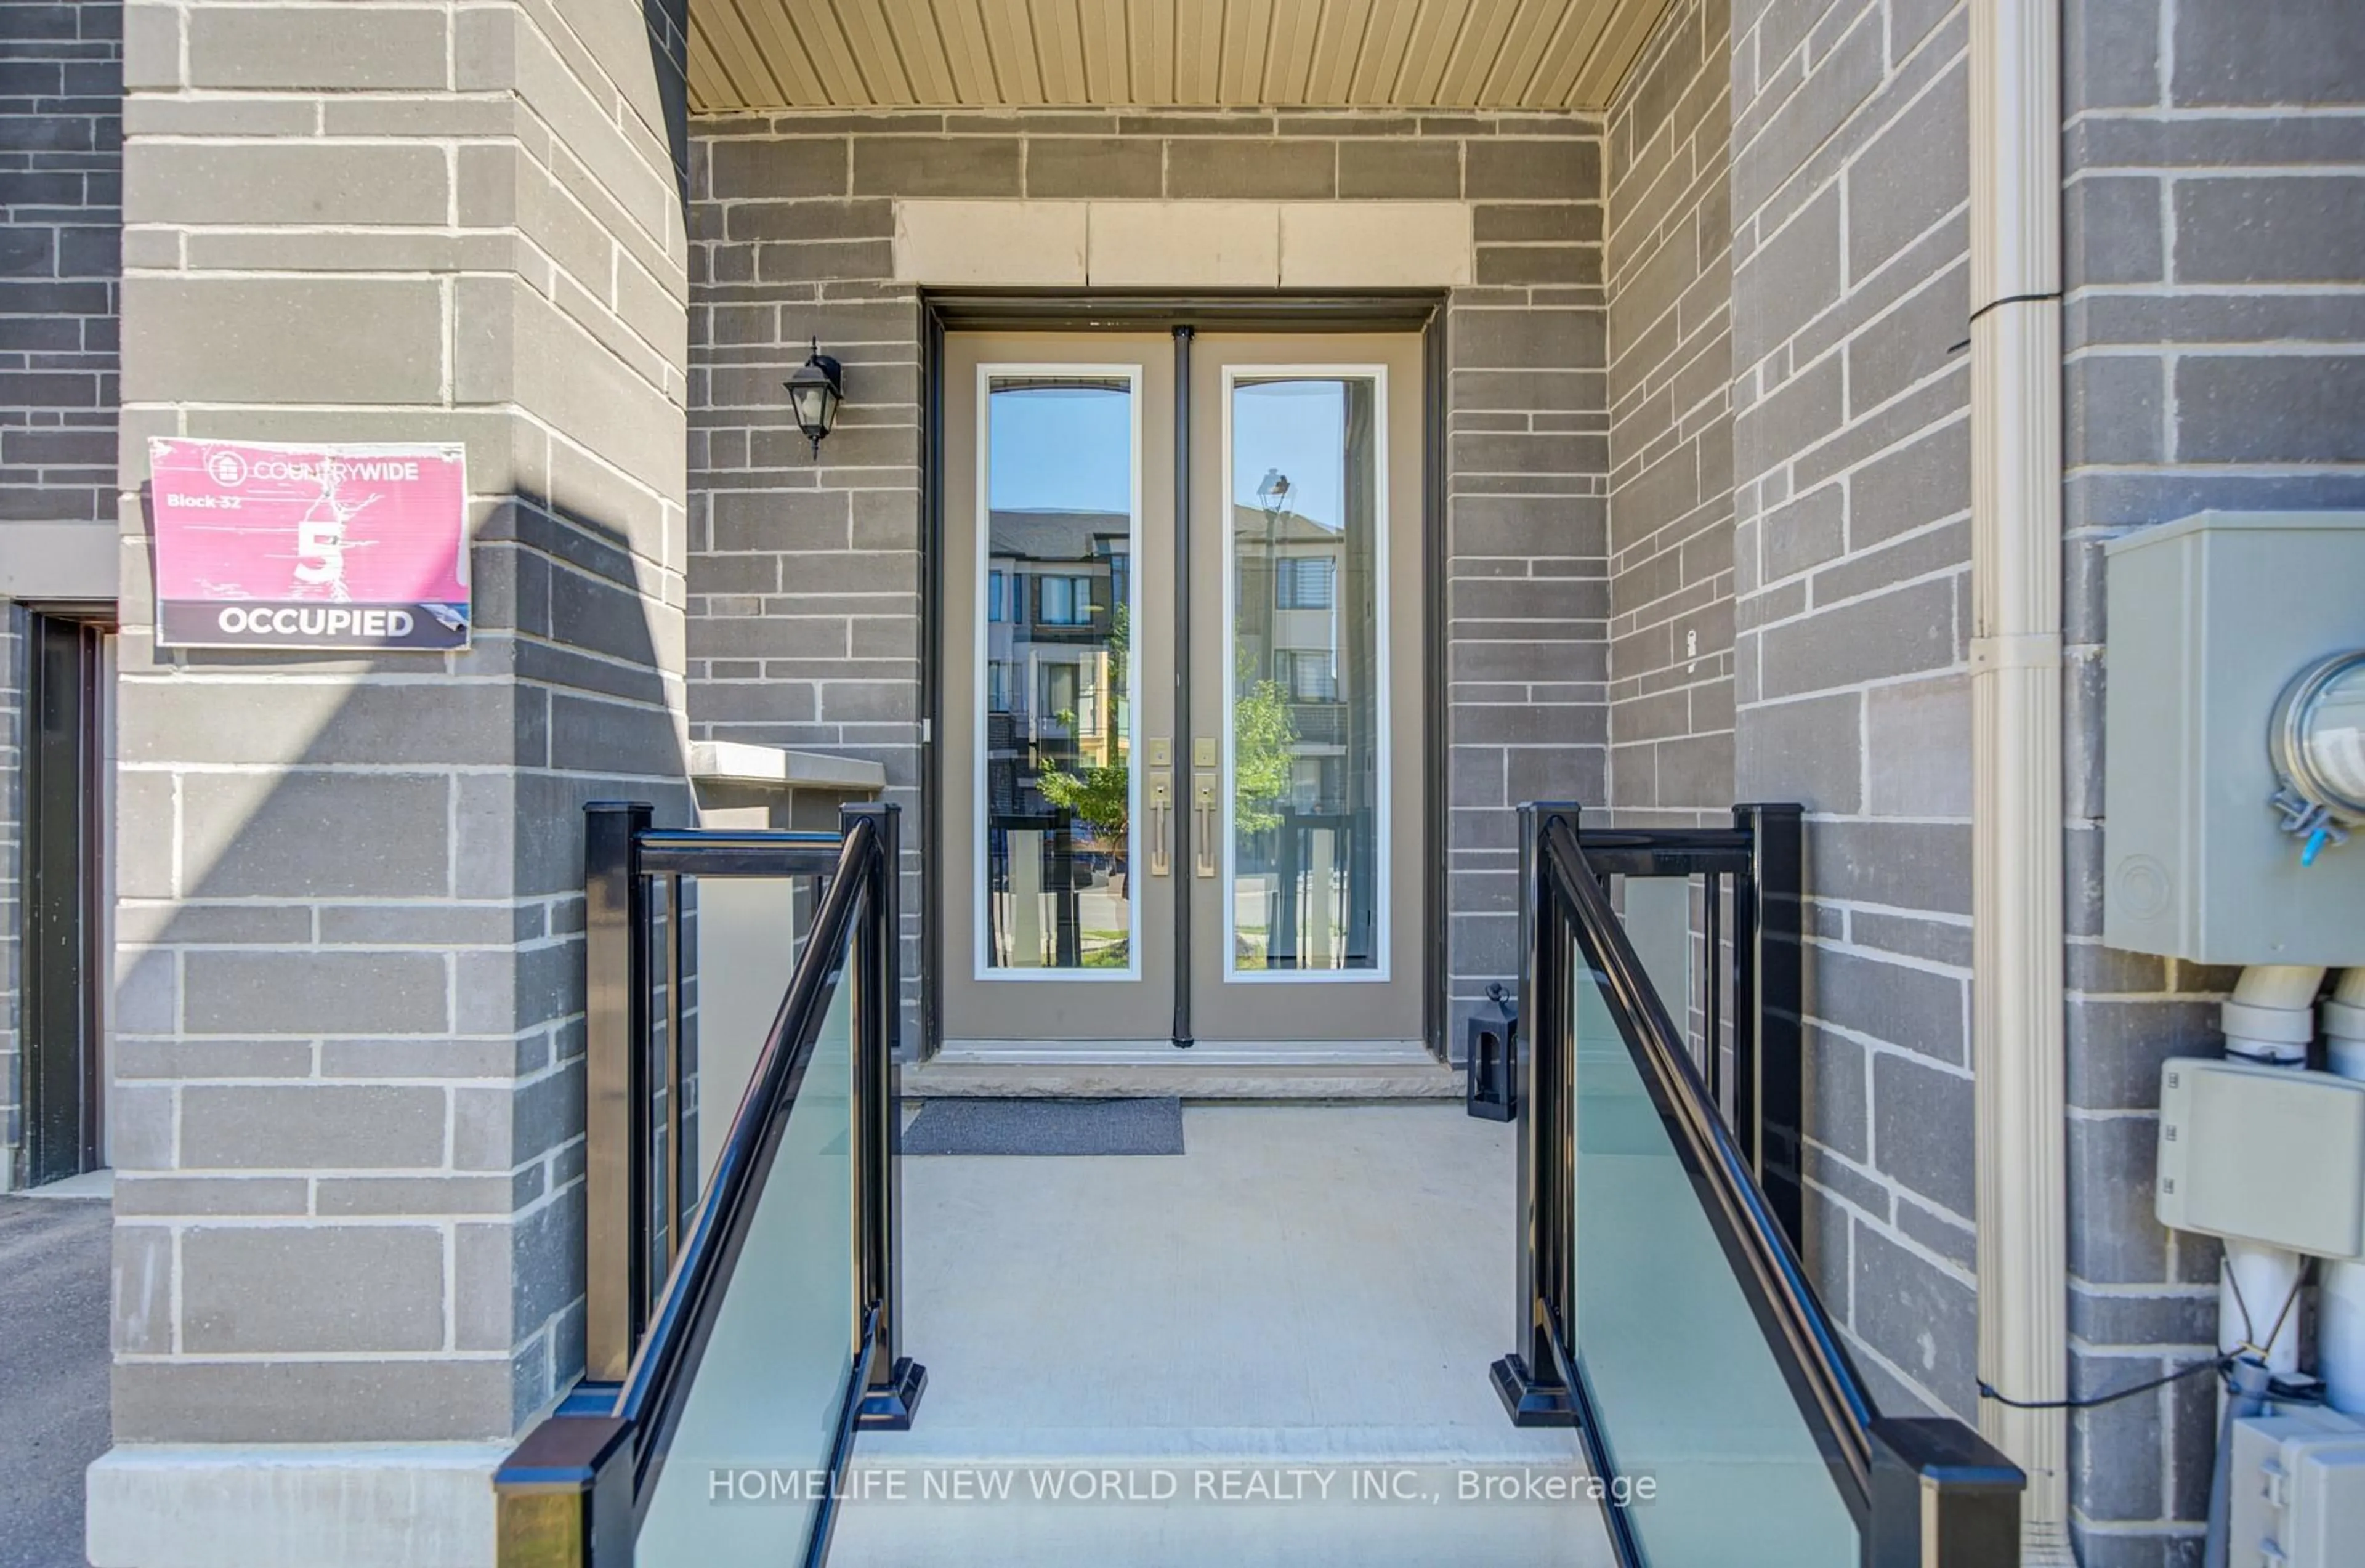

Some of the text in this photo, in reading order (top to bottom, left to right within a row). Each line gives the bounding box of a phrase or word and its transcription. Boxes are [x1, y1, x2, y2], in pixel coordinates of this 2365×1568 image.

[253, 461, 419, 481] COUNTRYWIDE
[167, 493, 216, 508] Block
[293, 521, 344, 584] 5
[218, 607, 414, 637] OCCUPIED
